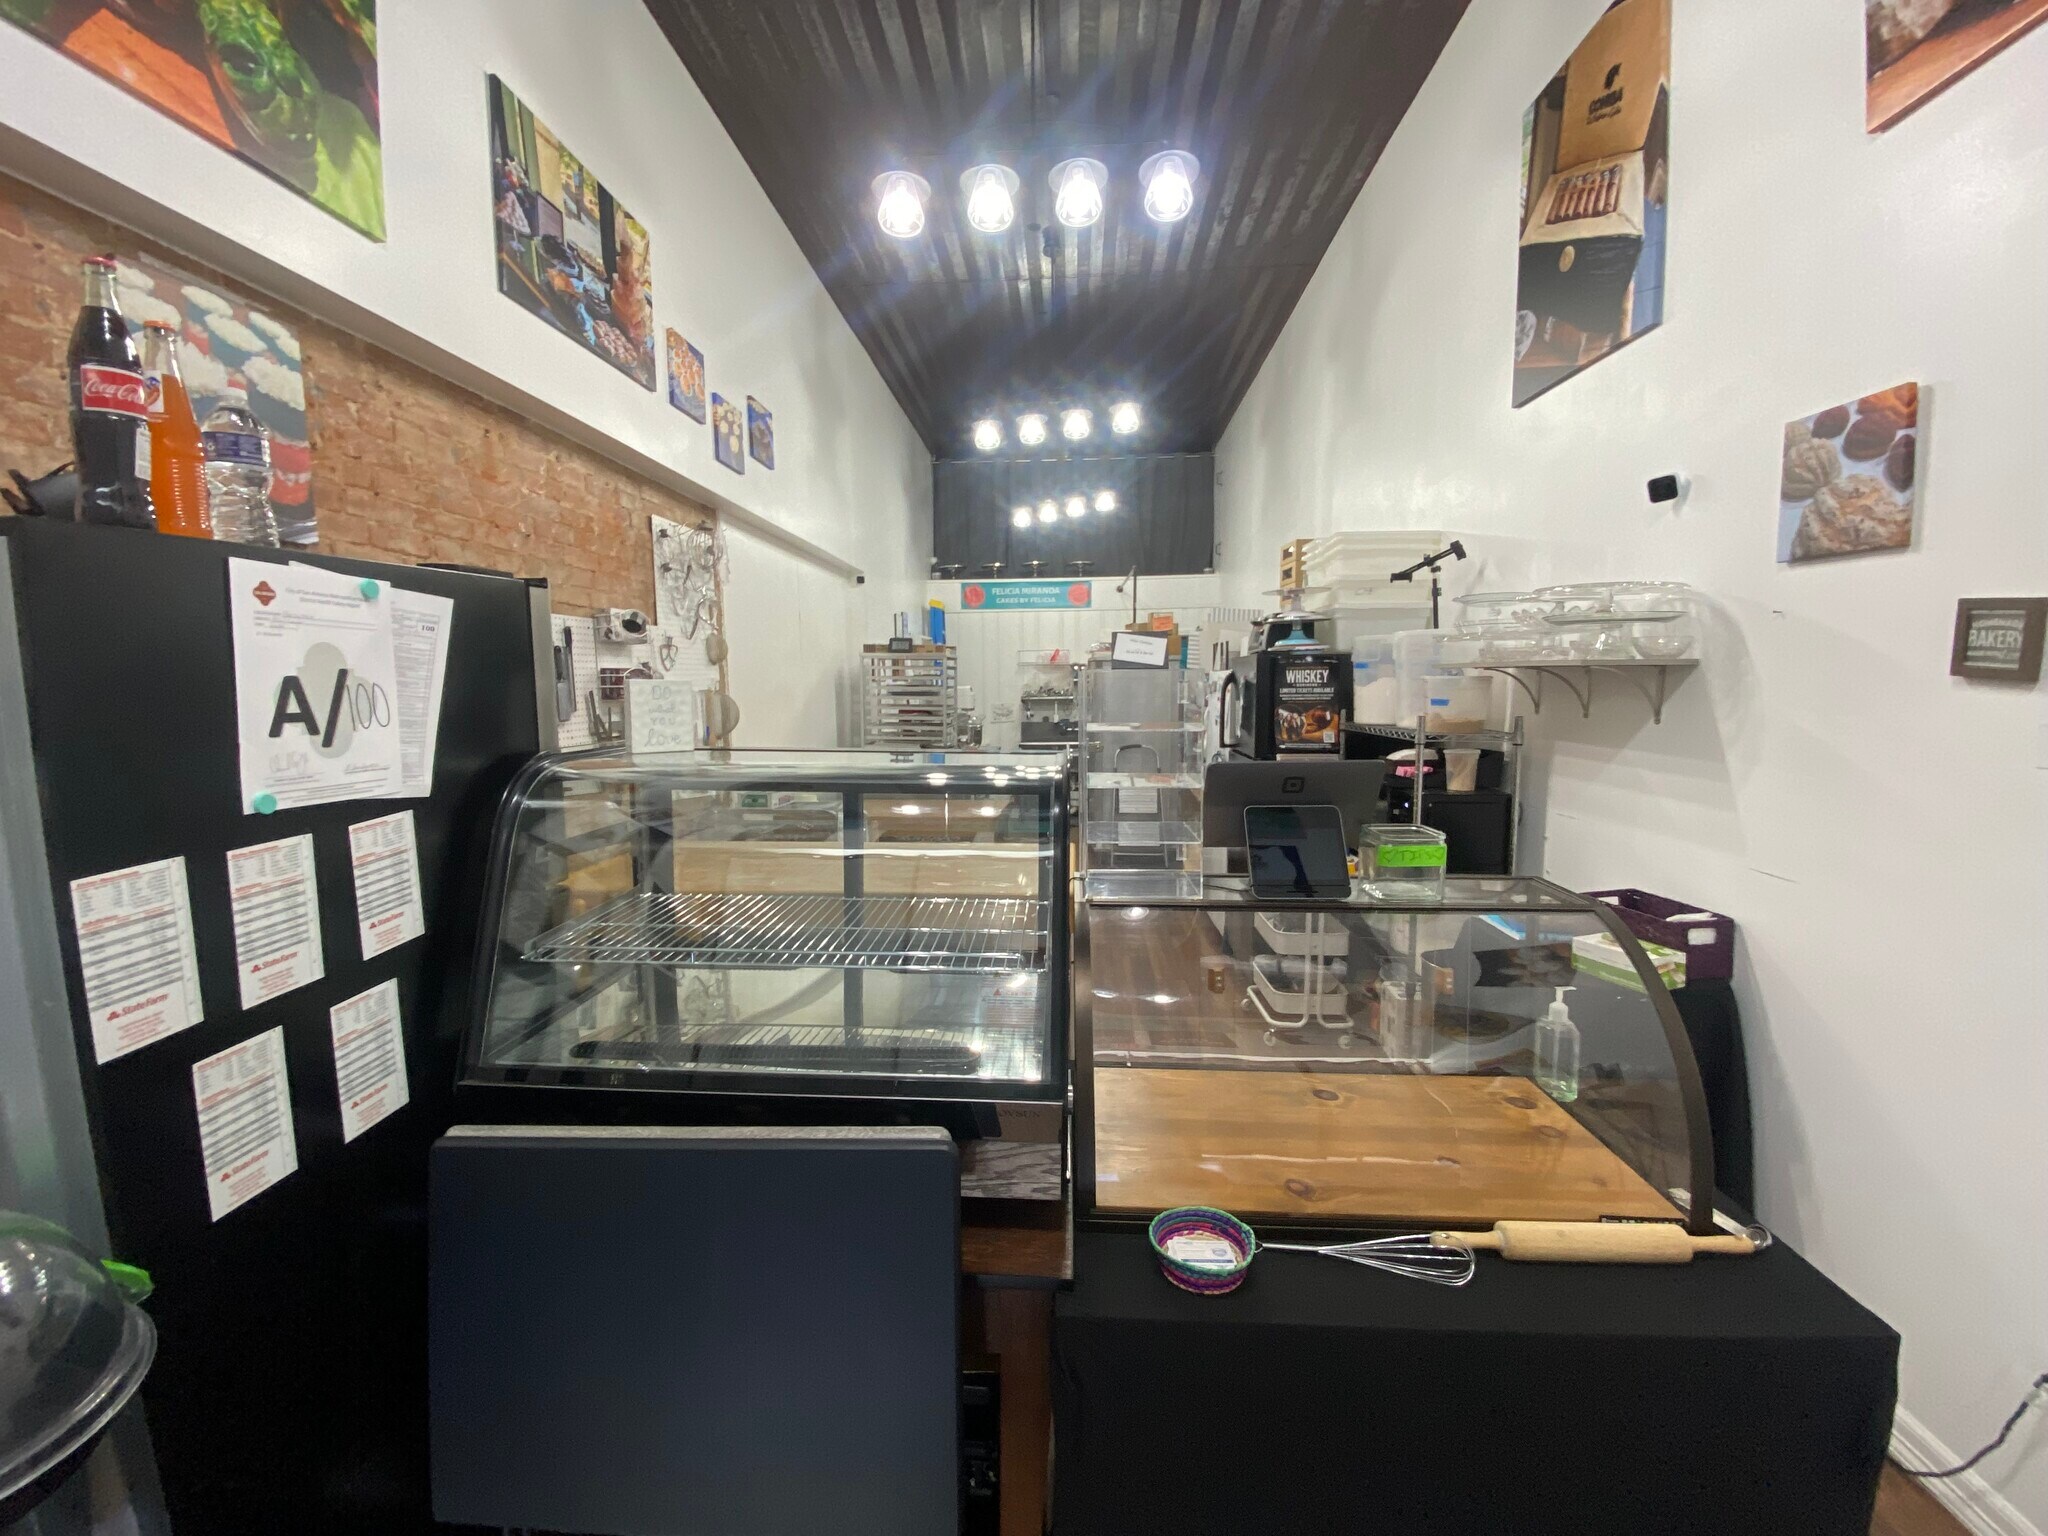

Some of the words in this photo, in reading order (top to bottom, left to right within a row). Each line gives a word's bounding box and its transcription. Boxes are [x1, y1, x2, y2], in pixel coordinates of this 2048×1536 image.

[992, 587, 1020, 595] FELICIA
[1021, 586, 1060, 595] MIRANDA
[1967, 629, 2022, 648] BAKERY
[1286, 669, 1330, 683] WHISKEY
